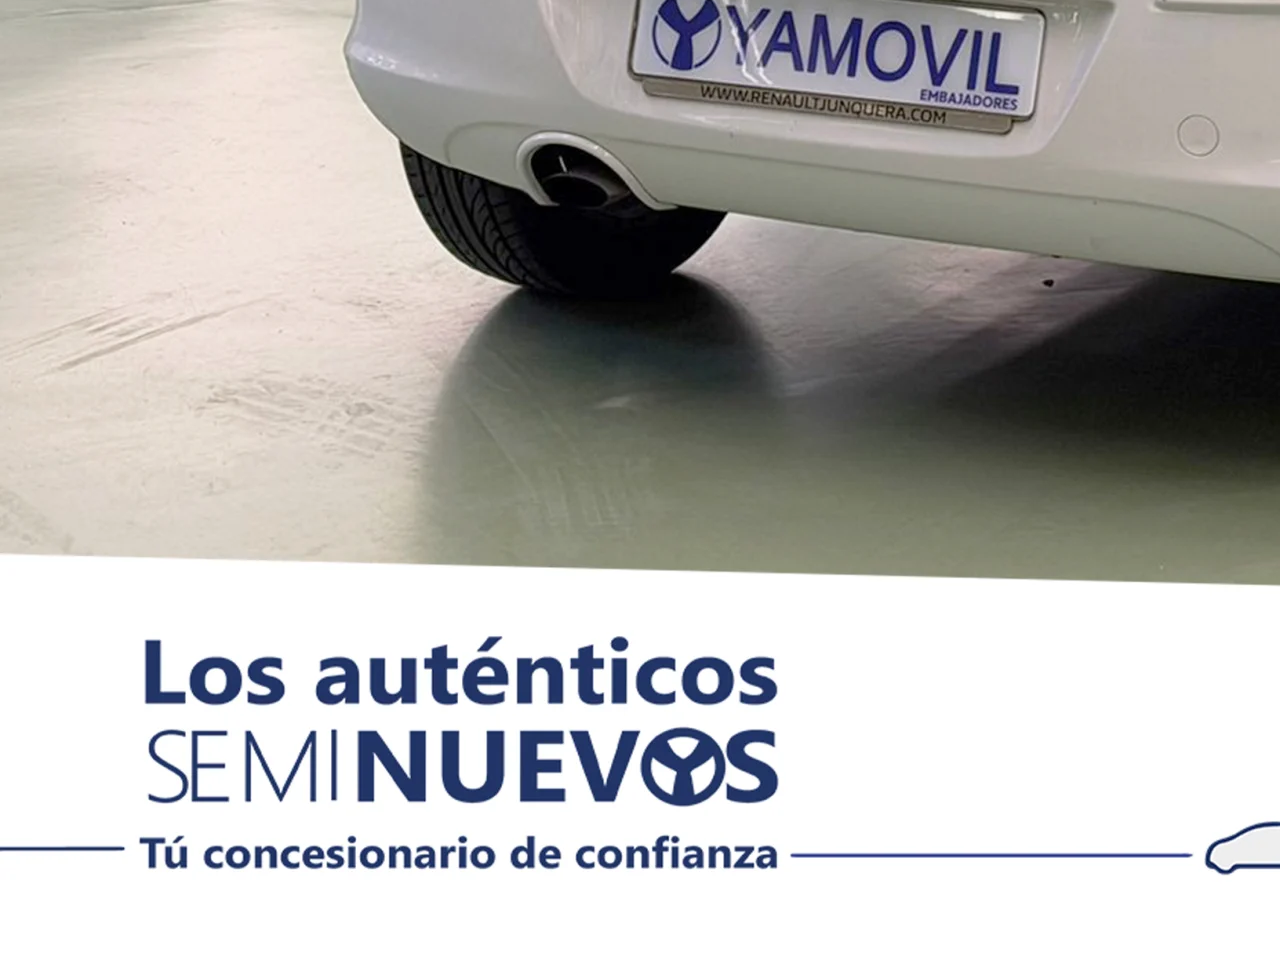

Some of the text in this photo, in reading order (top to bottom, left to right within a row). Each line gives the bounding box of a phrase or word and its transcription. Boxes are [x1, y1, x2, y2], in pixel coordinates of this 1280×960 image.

[725, 5, 1019, 95] YAMOVIL
[700, 85, 947, 125] WWW.RENAULTJUNQUERA.COM
[919, 88, 1019, 111] EMBAJADORES
